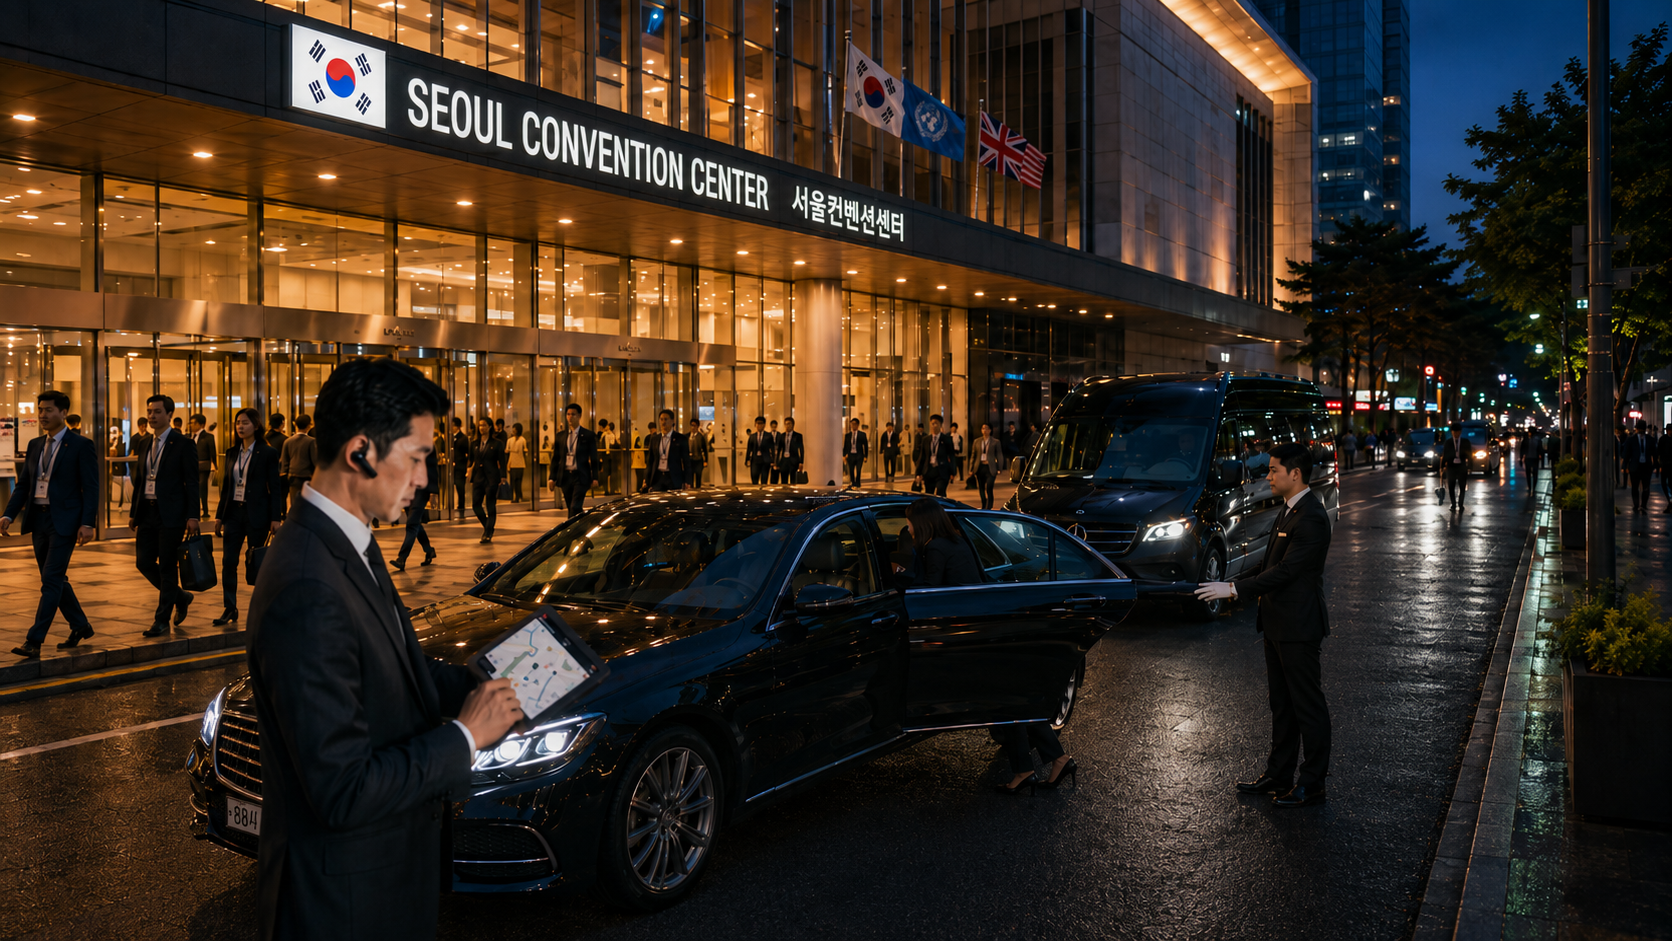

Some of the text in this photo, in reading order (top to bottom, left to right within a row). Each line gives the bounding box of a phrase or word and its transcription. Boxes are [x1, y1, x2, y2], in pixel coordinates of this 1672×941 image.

[407, 77, 770, 211] SEOUL CONVENTION CENTER
[791, 185, 904, 242] 서울컨벤션센터
